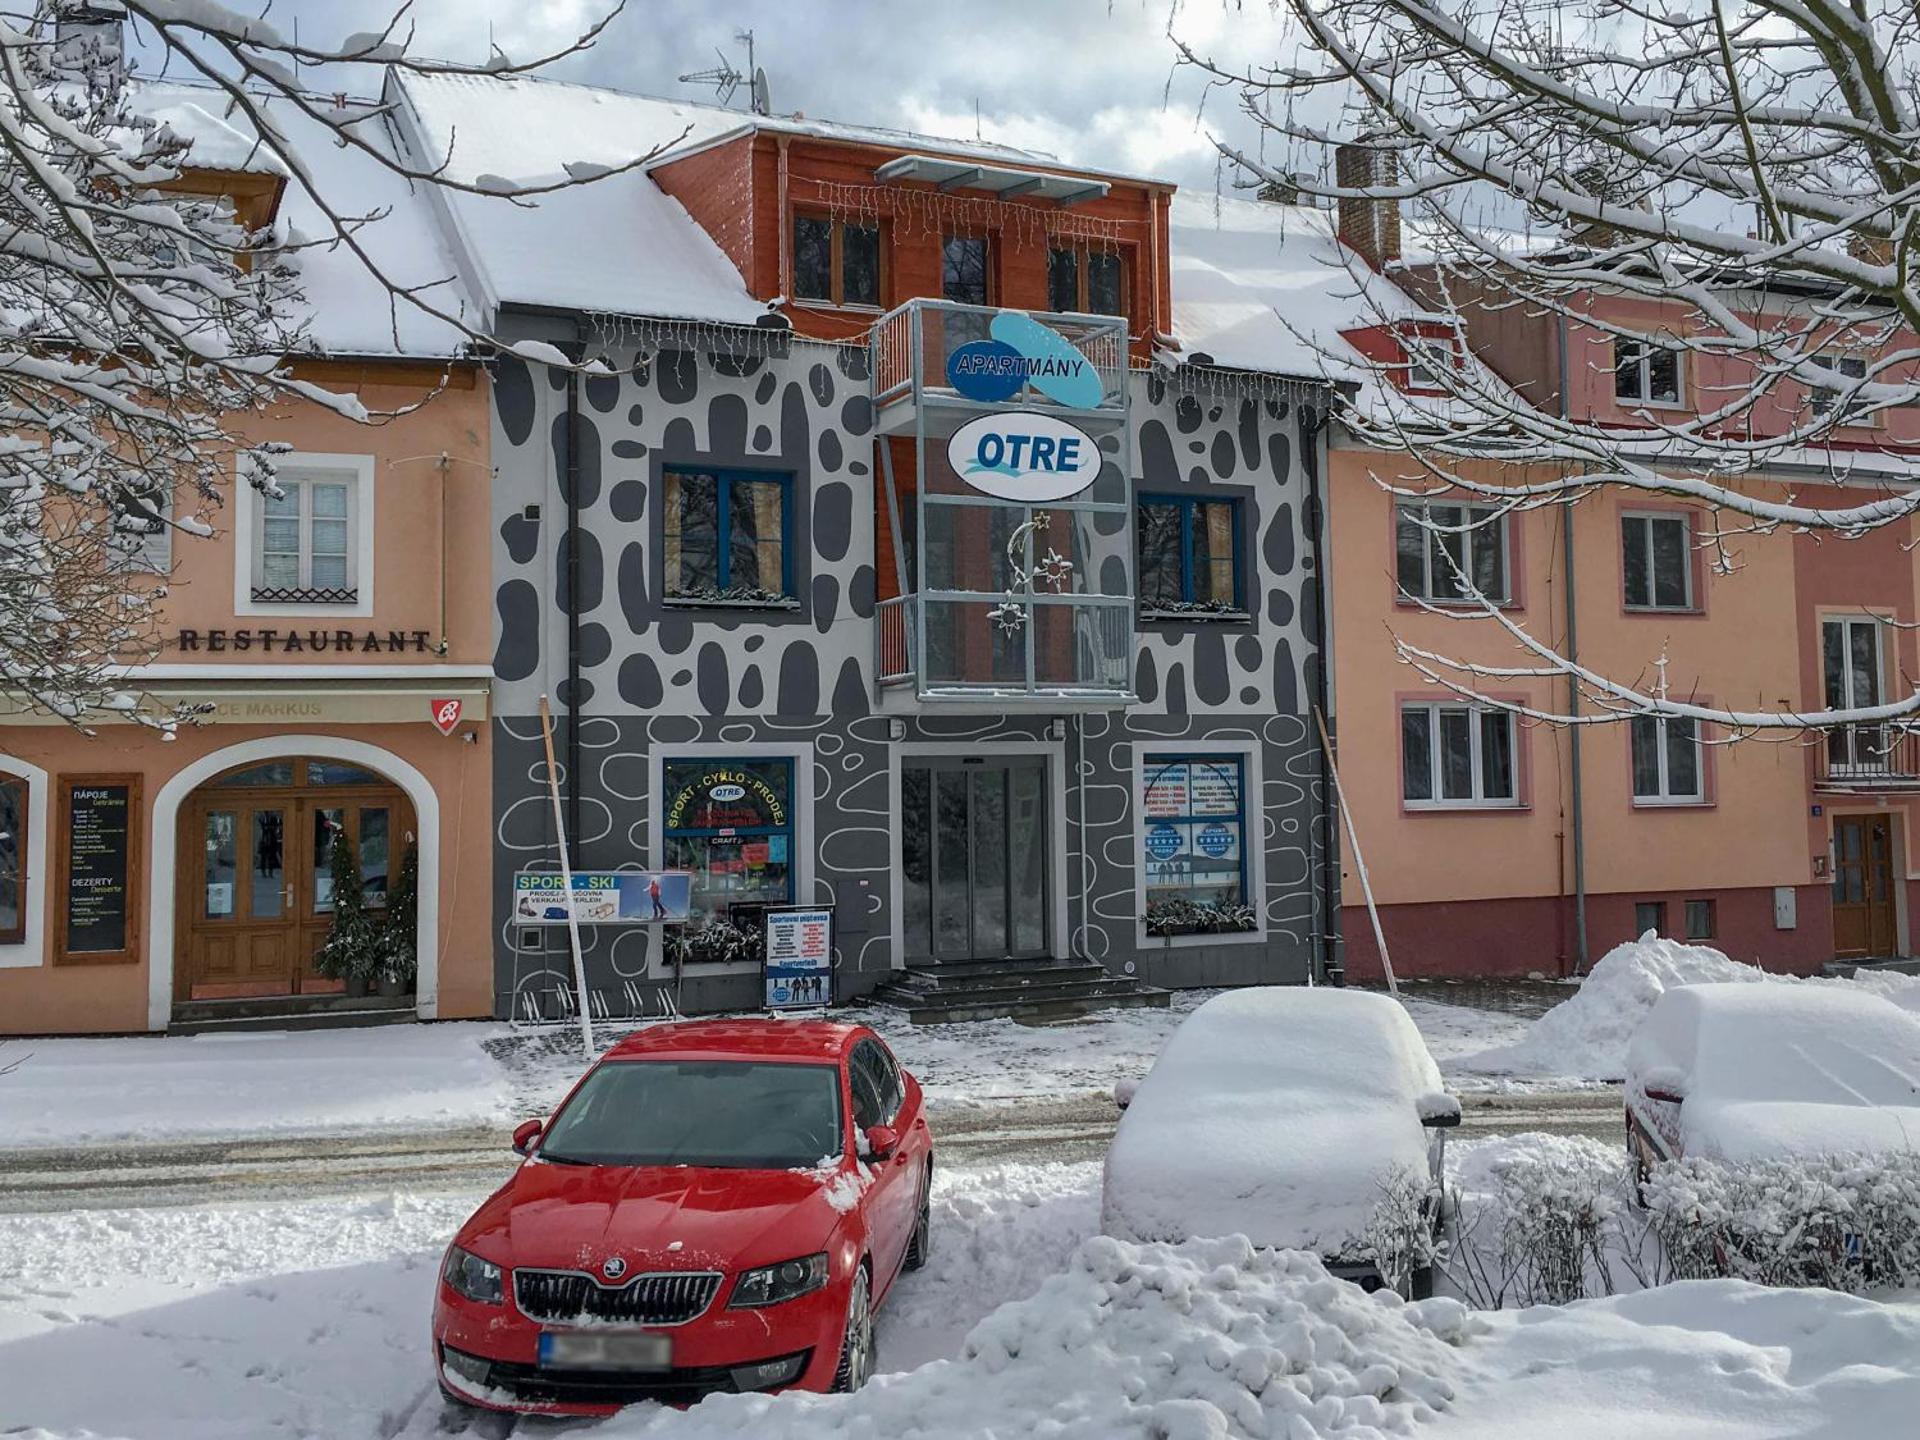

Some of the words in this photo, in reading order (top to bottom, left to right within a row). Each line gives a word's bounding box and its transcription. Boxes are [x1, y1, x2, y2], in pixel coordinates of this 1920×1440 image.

[956, 354, 1084, 378] APARTMÁNY
[977, 432, 1081, 473] OTRE
[178, 629, 430, 652] RESTAURANT
[246, 703, 322, 717] MARKUS
[715, 787, 741, 797] OTRE
[668, 785, 696, 829] SPORT
[753, 780, 785, 827] PRODEJ
[72, 878, 113, 886] DEZERTY
[519, 877, 576, 889] SPOR
[589, 876, 615, 889] SKI
